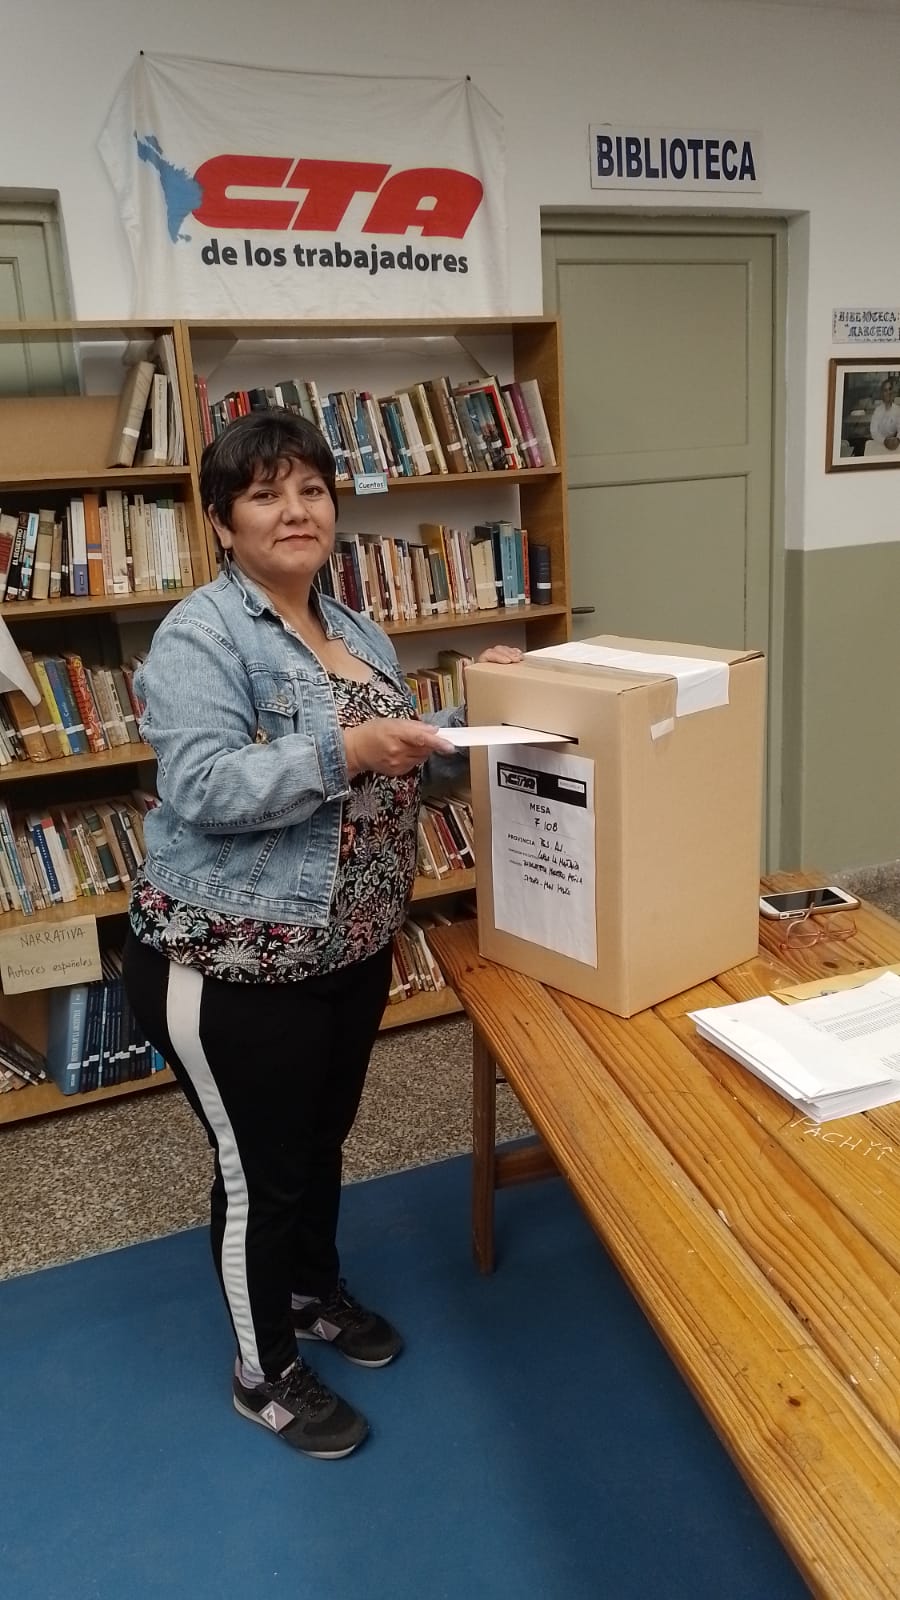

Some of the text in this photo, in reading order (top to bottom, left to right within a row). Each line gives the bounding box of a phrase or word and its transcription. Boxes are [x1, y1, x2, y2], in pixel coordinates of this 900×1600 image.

[597, 135, 756, 180] BIBLIOTECA
[192, 154, 484, 239] CTA
[201, 238, 469, 275] de los trabajadores
[529, 803, 551, 814] MESA
[508, 833, 535, 846] PROVINCIA
[20, 927, 85, 948] NARRATIVA
[7, 957, 93, 979] Autores españoles
